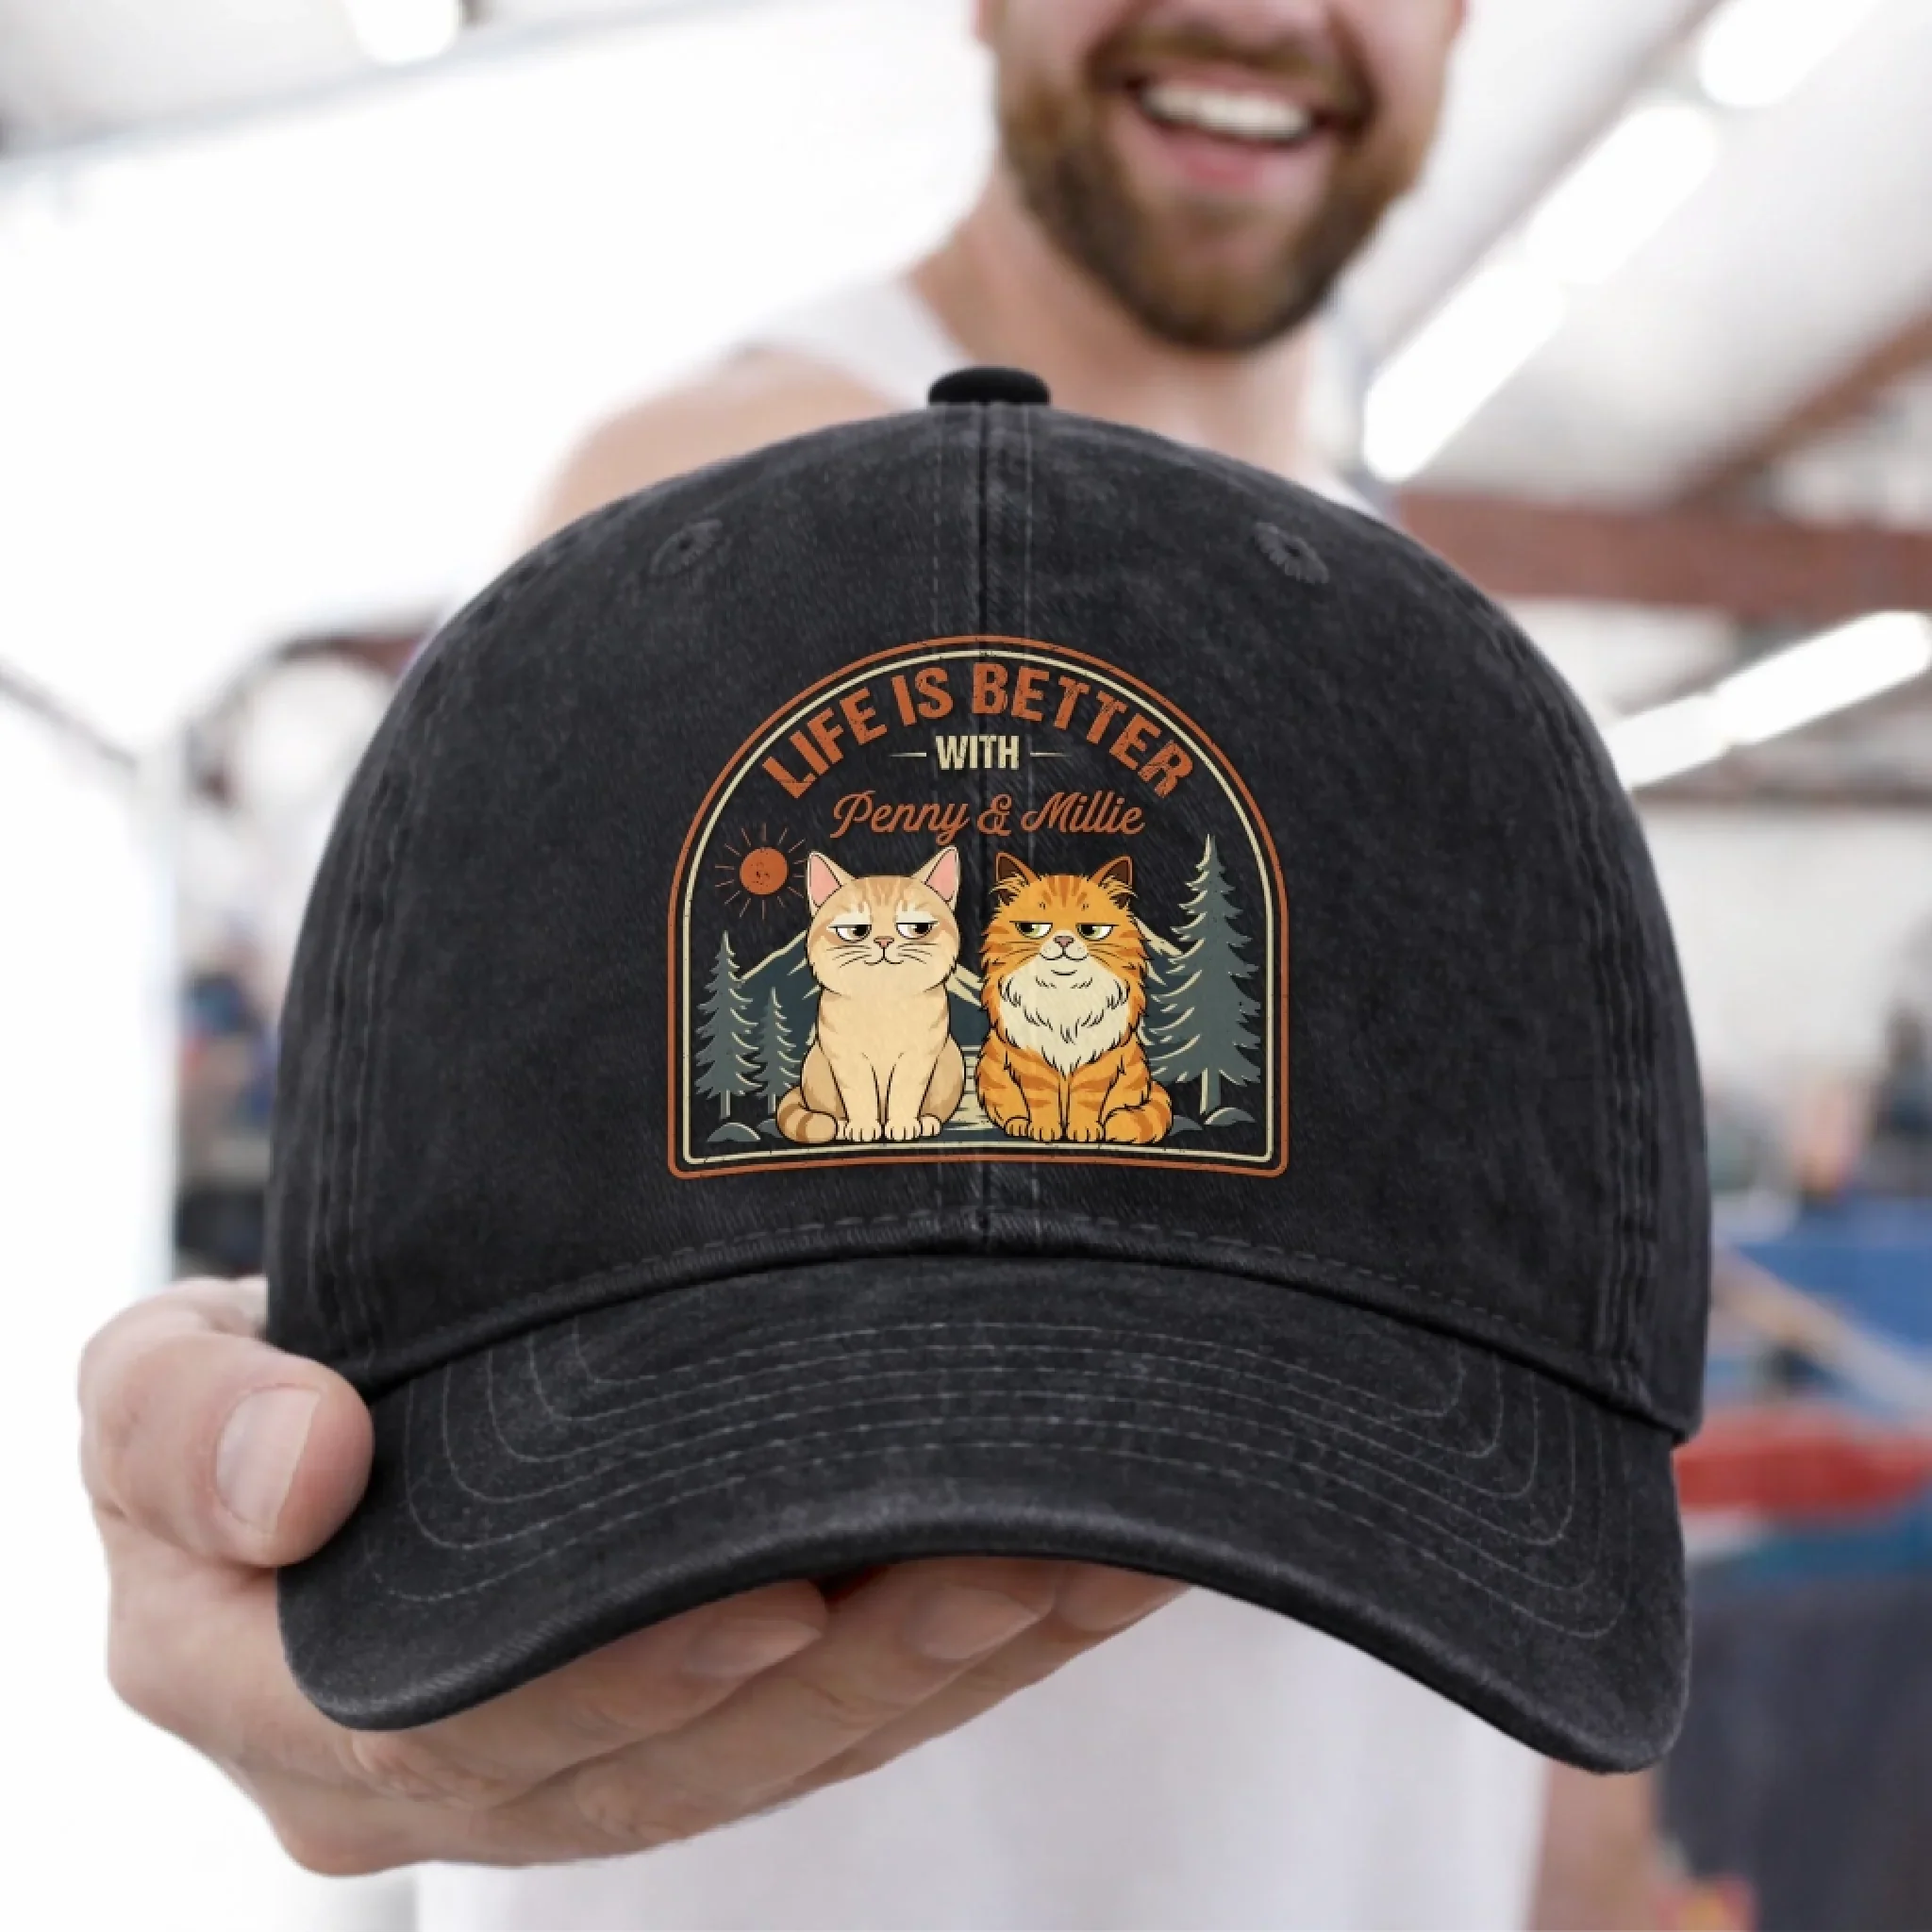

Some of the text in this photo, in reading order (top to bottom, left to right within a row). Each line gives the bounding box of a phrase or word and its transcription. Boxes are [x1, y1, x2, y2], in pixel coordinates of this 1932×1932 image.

[761, 662, 1194, 799] LIFE IS BETTER
[935, 735, 1020, 771] WITH
[829, 790, 1146, 845] Penny & Millie
